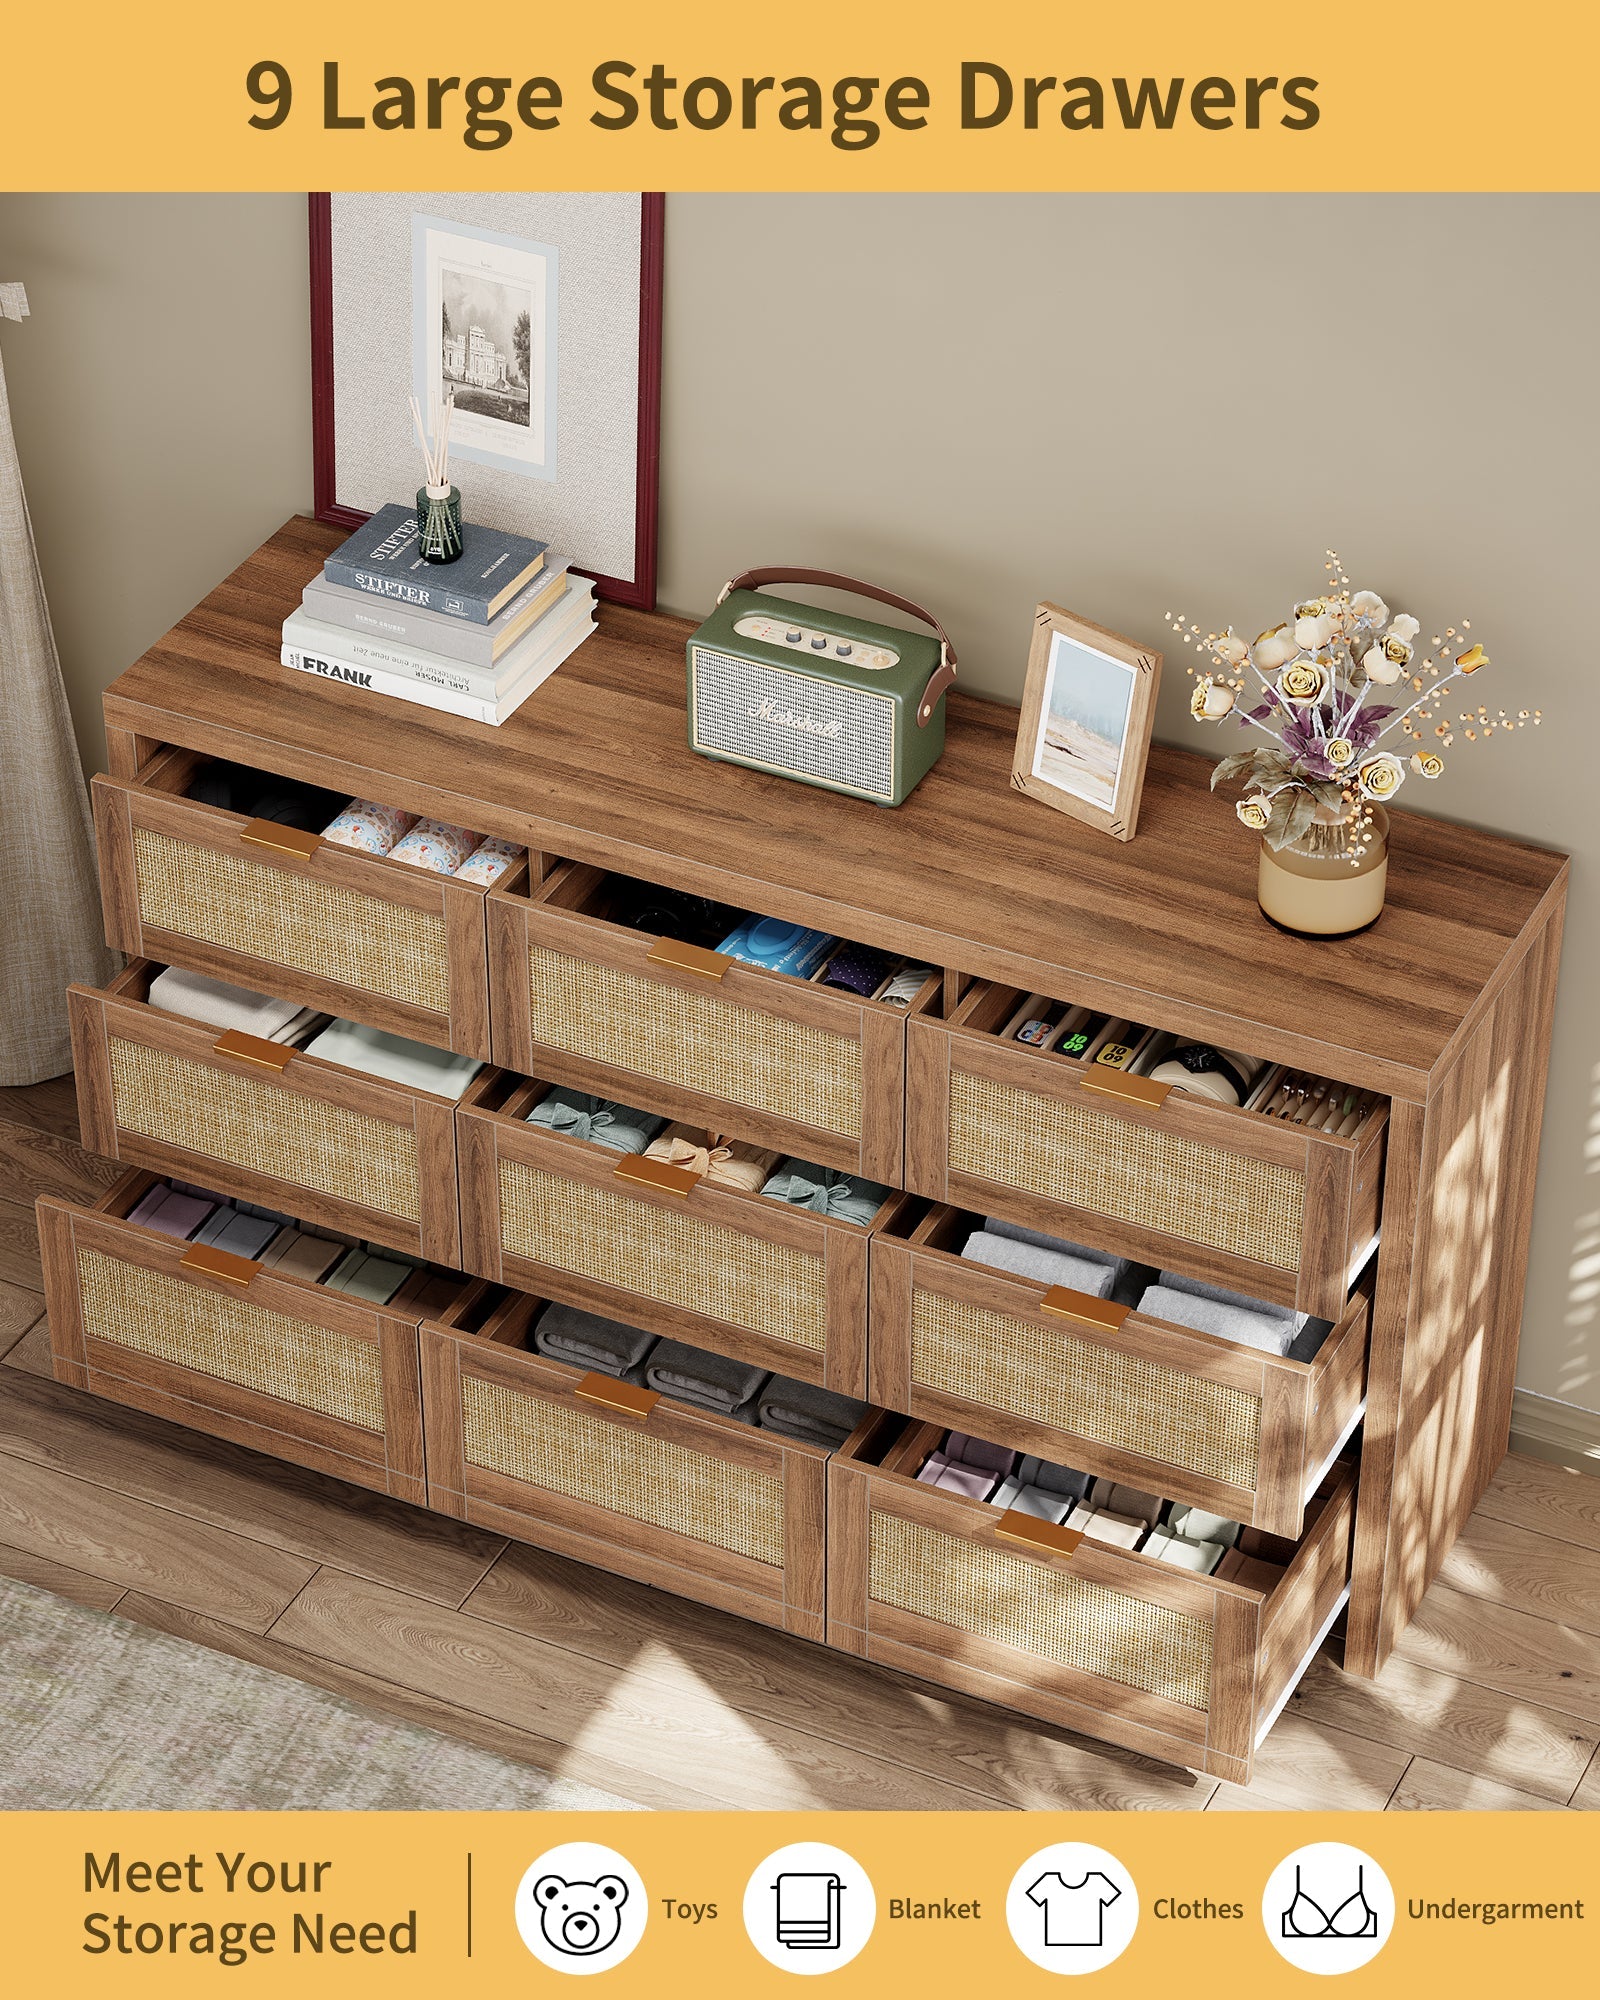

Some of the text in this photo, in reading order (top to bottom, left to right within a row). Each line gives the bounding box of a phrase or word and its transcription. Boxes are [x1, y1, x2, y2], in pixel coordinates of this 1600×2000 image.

[370, 519, 419, 560] STIFTER
[355, 573, 431, 603] STIFTER
[353, 645, 368, 656] Zeit
[370, 650, 390, 661] neue
[392, 656, 409, 666] eine
[303, 656, 372, 688] FRANK
[415, 671, 470, 692] CARL MOSER
[747, 700, 842, 738] Marshall
[1069, 1033, 1088, 1044] 10
[1063, 1041, 1084, 1052] 09
[1110, 1045, 1128, 1055] 10
[1103, 1052, 1123, 1063] 09
